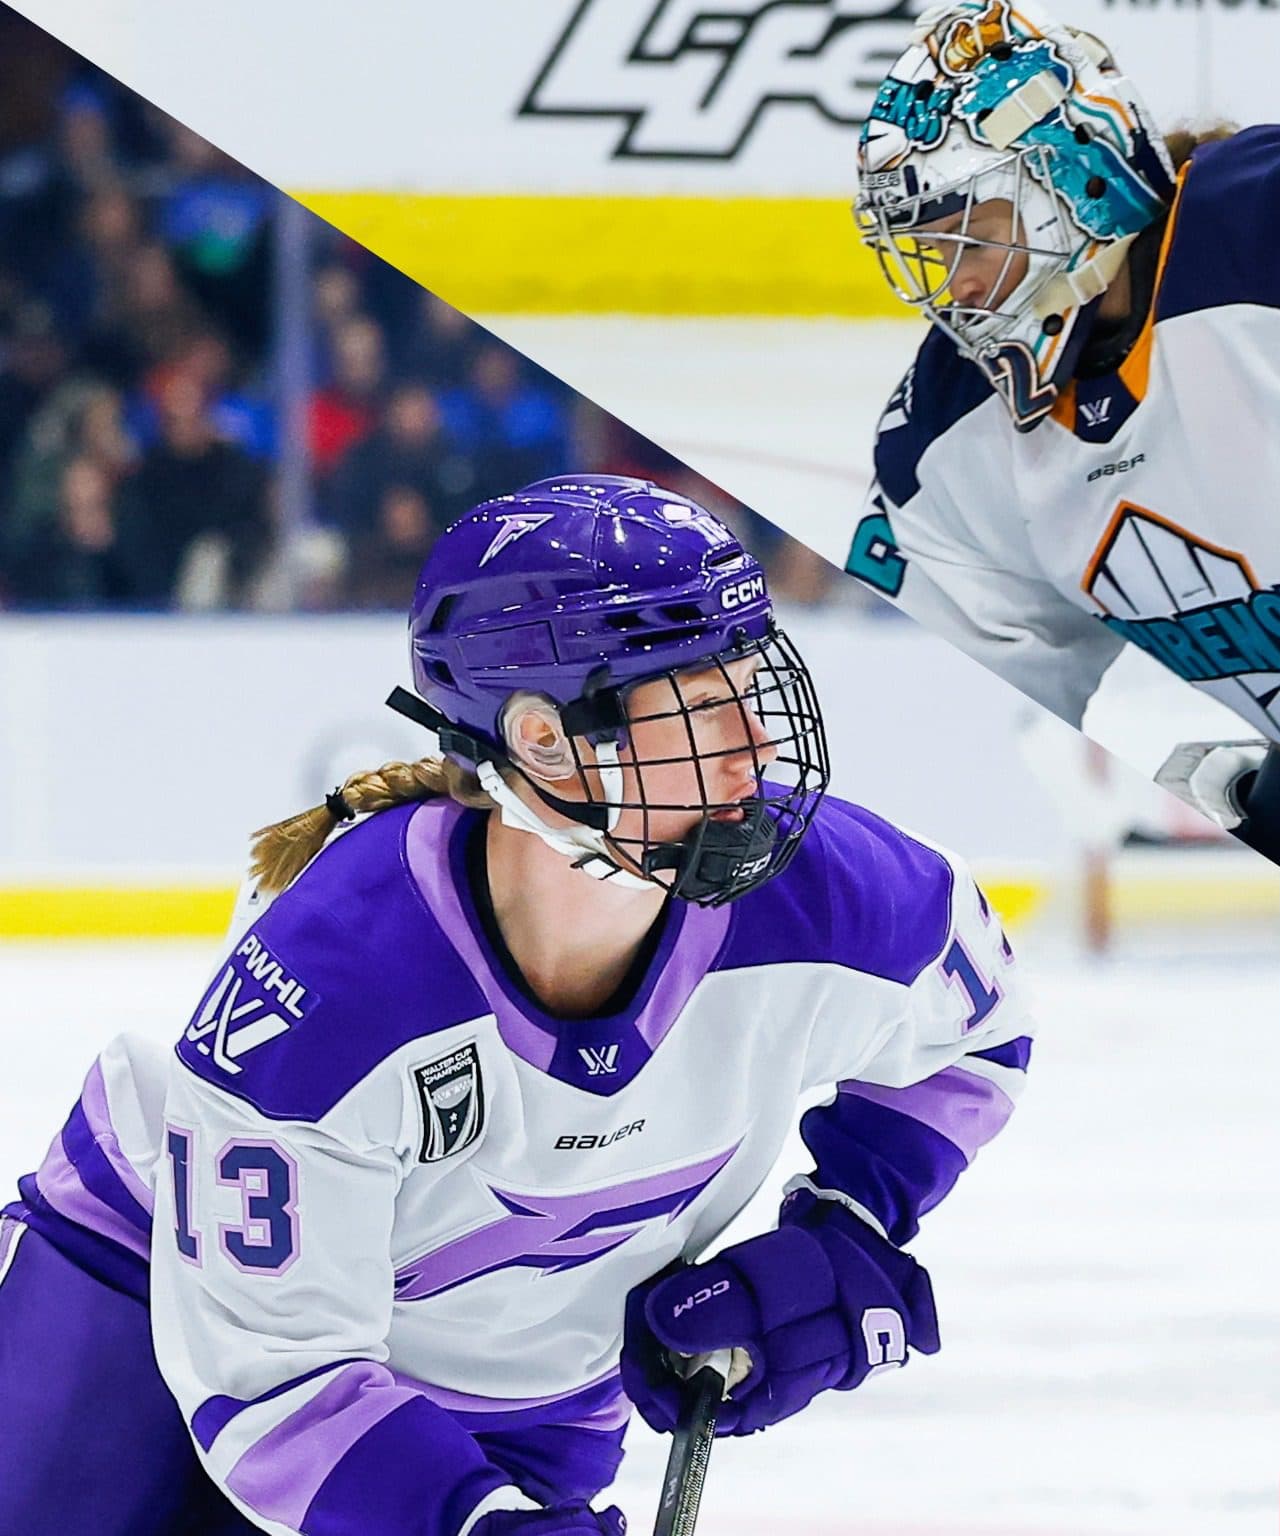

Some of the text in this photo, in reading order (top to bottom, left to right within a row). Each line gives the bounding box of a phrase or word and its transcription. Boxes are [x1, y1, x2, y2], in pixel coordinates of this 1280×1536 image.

[721, 576, 764, 609] CCM
[236, 933, 307, 1019] PWHL
[420, 1047, 473, 1078] WALTER CUP
[423, 1056, 474, 1085] CHAMPIONS
[552, 1118, 647, 1150] BAUER
[166, 1122, 304, 1279] 13
[673, 1280, 731, 1318] CCM
